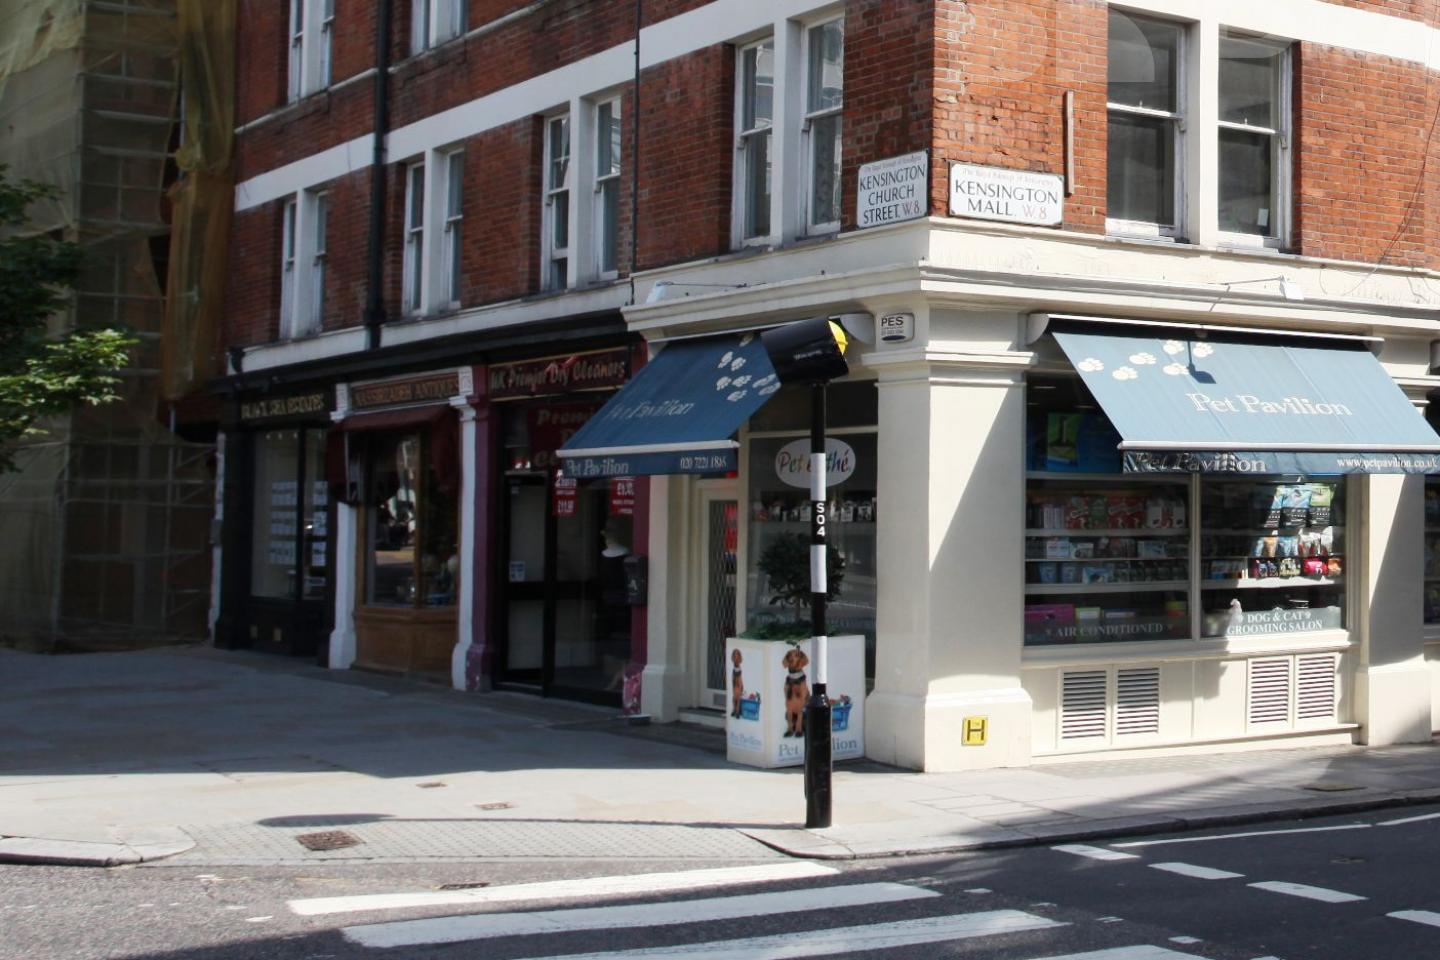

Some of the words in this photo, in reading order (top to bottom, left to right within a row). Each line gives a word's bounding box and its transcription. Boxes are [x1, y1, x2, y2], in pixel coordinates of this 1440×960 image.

[860, 164, 926, 192] KENSINGTON
[868, 184, 915, 206] CHURCH
[955, 180, 1058, 204] KENSINGTON
[967, 198, 1017, 217] MALL.
[881, 316, 904, 327] PES
[549, 361, 570, 386] Dry
[573, 358, 625, 379] Cleaners
[1185, 392, 1238, 413] Pet
[1237, 394, 1353, 416] Pavilion
[583, 458, 629, 476] Pavilion
[778, 451, 804, 475] Pet
[1134, 452, 1172, 472] Pet
[1173, 452, 1267, 473] Pavilion
[1336, 455, 1440, 470] www.petpavilion.co.uk
[816, 503, 826, 537] S04
[1226, 622, 1286, 636] GROOMING
[1287, 619, 1324, 632] SALON
[1247, 612, 1271, 623] DOG
[1272, 611, 1281, 621] &
[1283, 611, 1304, 621] CAT
[1055, 626, 1078, 639] AIR
[1079, 623, 1163, 637] CONDITIONED
[967, 720, 985, 742] H
[778, 743, 799, 757] Pet
